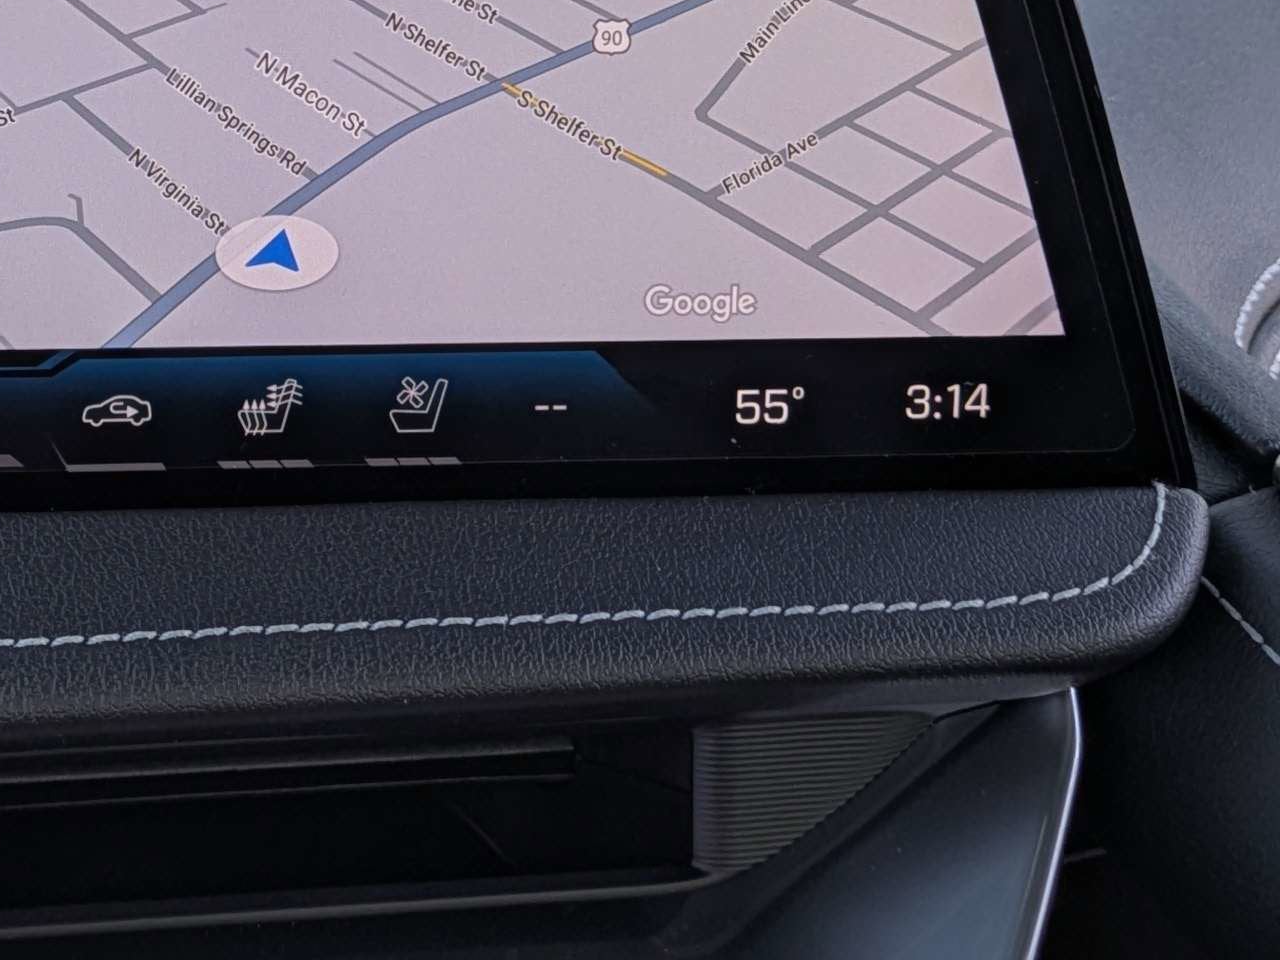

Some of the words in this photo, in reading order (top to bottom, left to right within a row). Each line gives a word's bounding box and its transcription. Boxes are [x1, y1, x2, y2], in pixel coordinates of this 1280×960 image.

[477, 3, 498, 24] St
[601, 30, 622, 46] 90
[385, 13, 403, 33] N
[403, 23, 465, 70] Shelfer
[465, 60, 486, 81] St
[738, 21, 778, 63] Main
[256, 52, 275, 75] N
[275, 66, 342, 121] Macon
[342, 113, 365, 137] St
[166, 68, 216, 113] Lillian
[217, 106, 279, 159] Springs
[280, 150, 307, 176] Rd
[517, 90, 533, 109] S
[533, 101, 598, 149] Shelfer
[599, 139, 622, 161] St
[722, 152, 784, 195] Florida
[786, 132, 818, 162] Ave
[128, 148, 148, 168] N
[148, 161, 204, 218] Virginia
[205, 213, 225, 236] St
[645, 284, 757, 323] Google
[734, 386, 806, 425] 55°
[904, 382, 992, 420] 3:14
